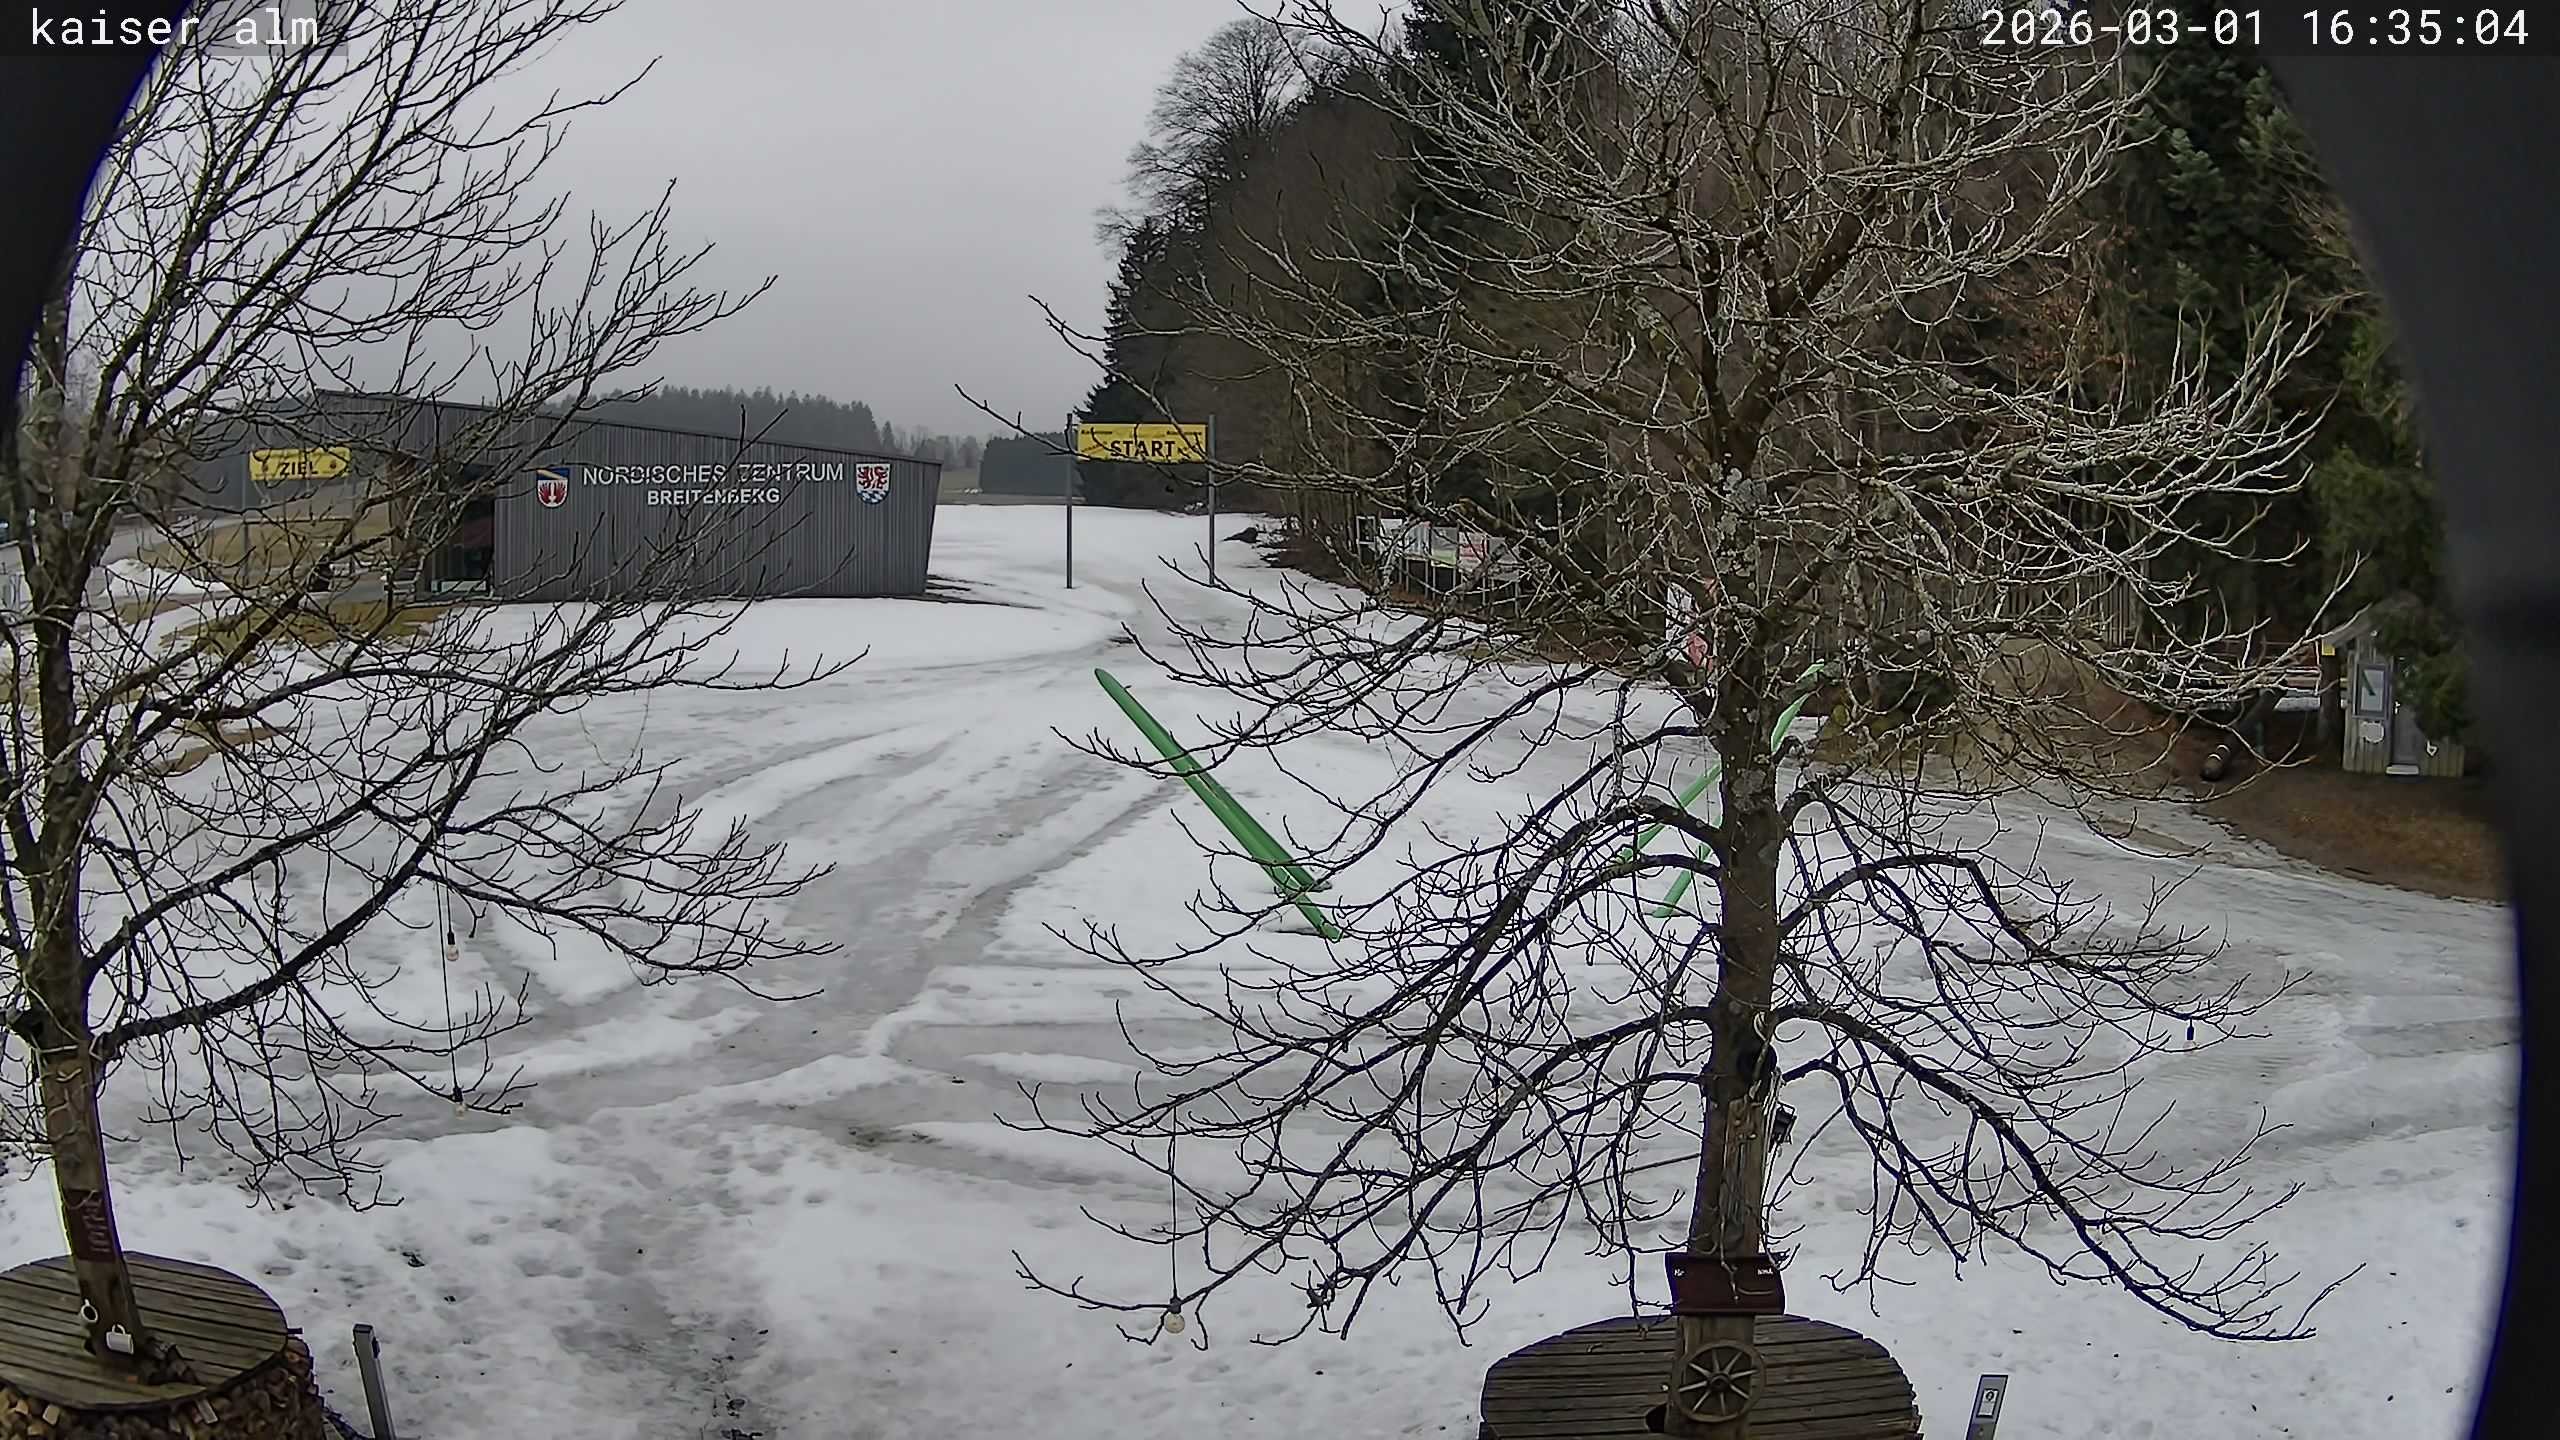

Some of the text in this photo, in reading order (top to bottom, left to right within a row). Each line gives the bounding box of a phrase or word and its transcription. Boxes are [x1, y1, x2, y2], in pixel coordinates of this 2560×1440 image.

[1110, 440, 1176, 457] START
[279, 461, 318, 476] ZIEL
[583, 462, 844, 485] NORDISCHES ZENTRUM
[647, 487, 781, 506] BREITENBERG
